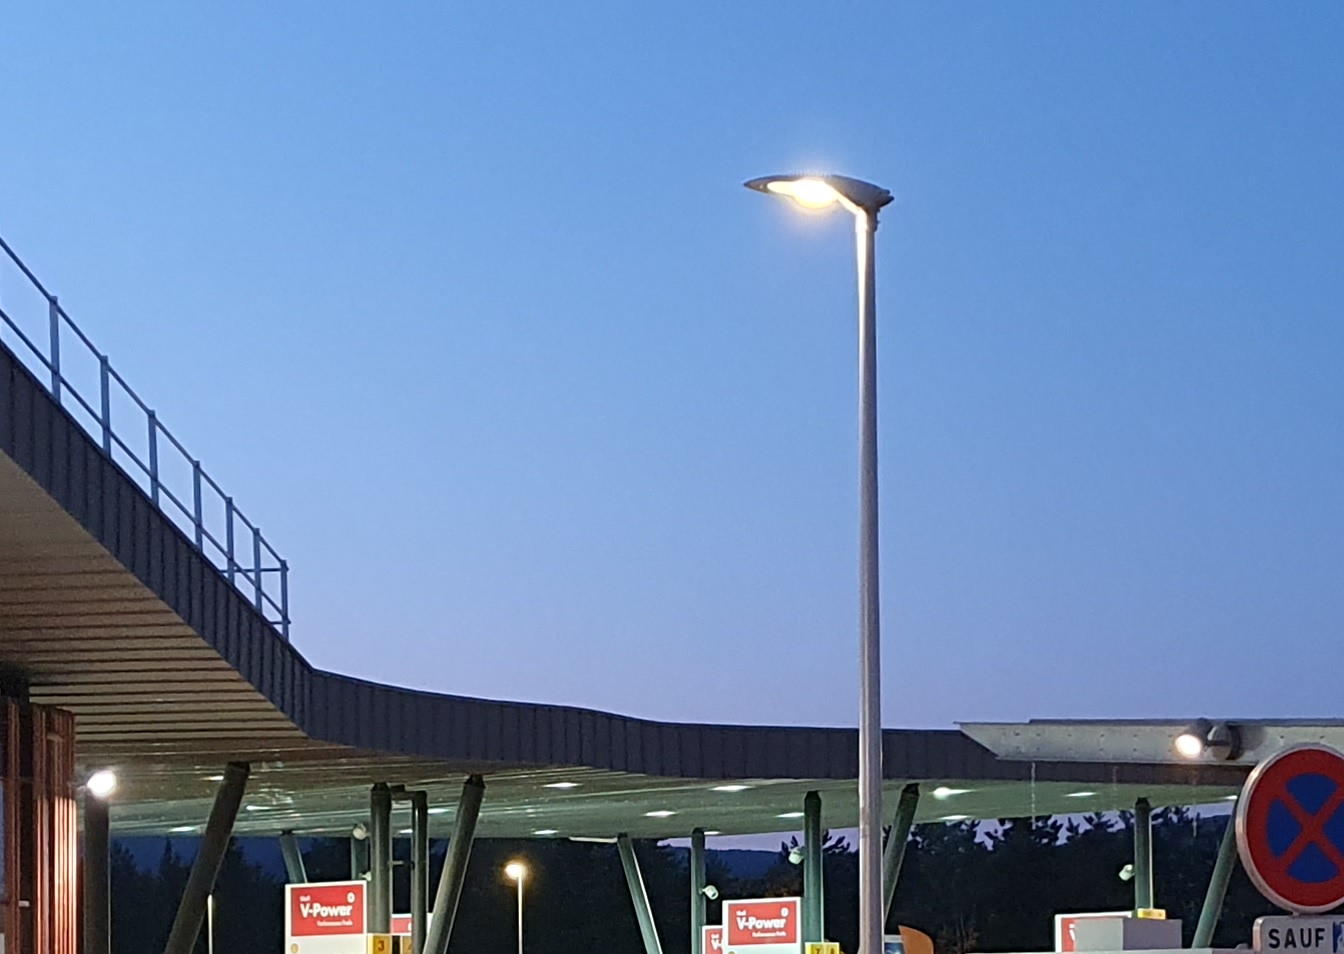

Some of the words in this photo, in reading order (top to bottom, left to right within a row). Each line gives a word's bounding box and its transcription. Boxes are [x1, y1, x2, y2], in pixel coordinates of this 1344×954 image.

[300, 903, 352, 918] V-Power
[736, 916, 787, 931] V-Power
[378, 940, 385, 952] 3
[1268, 928, 1325, 949] SAUF
